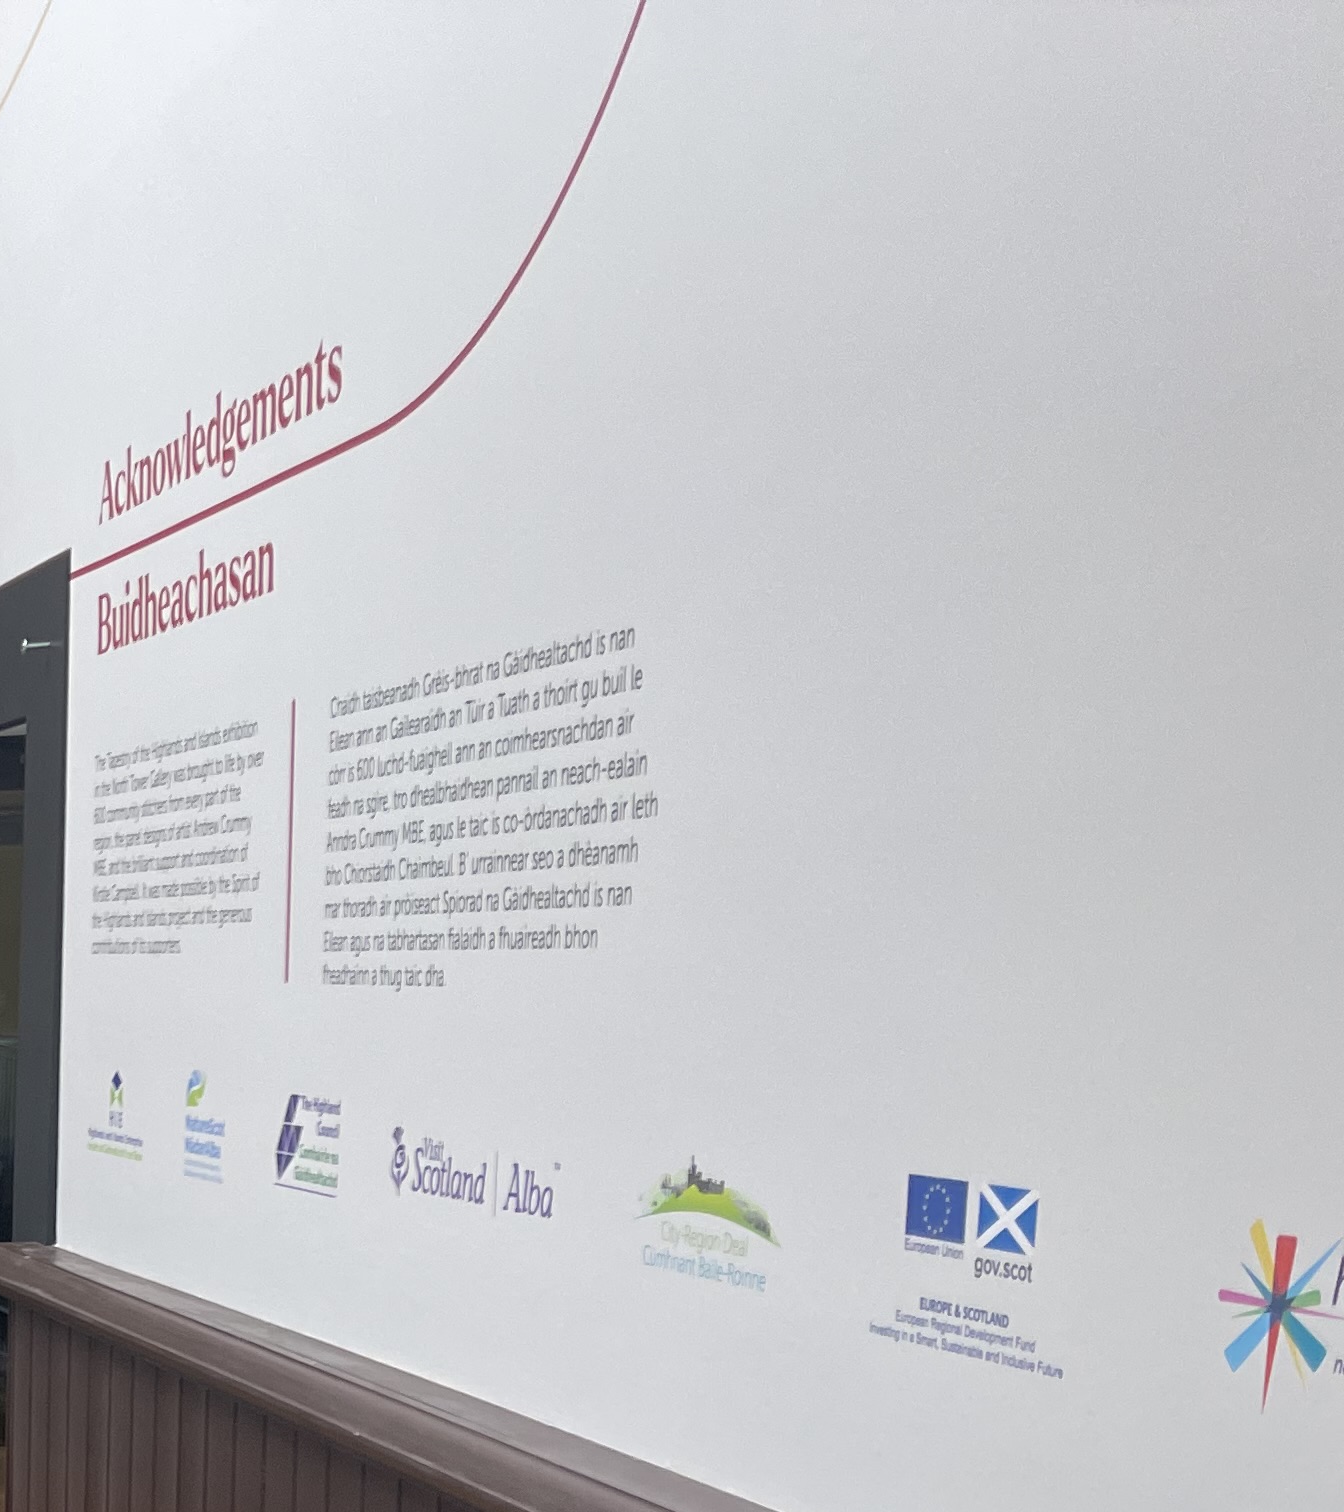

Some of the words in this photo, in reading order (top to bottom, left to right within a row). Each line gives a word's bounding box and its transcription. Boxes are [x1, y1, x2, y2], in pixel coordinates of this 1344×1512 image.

[97, 338, 344, 526] Acknowledgements
[97, 541, 275, 656] Buidheachasan
[486, 660, 500, 681] na
[595, 628, 606, 656] is
[609, 626, 635, 652] nan
[356, 726, 374, 747] ann
[374, 723, 388, 743] an
[448, 707, 462, 728] an
[487, 700, 495, 720] a
[497, 687, 530, 717] Tuath
[532, 690, 540, 711] a
[543, 677, 578, 708] thoirt
[581, 677, 598, 708] gu
[602, 665, 627, 697] buil
[630, 663, 643, 691] le
[347, 761, 355, 783] is
[356, 755, 375, 781] 600
[455, 742, 476, 764] ann
[477, 739, 492, 761] an
[495, 714, 613, 757] coimhearsnachdan
[616, 707, 635, 737] air
[353, 797, 364, 816] na
[392, 789, 408, 810] tro
[496, 764, 539, 802] pannail
[541, 767, 558, 790] an
[561, 749, 647, 786] neach-ealain
[358, 826, 399, 851] Crummy
[429, 821, 454, 847] agus
[455, 815, 467, 839] le
[468, 811, 489, 838] taic
[491, 809, 500, 835] is
[610, 794, 628, 823] air
[631, 790, 658, 820] leth
[471, 849, 529, 875] urrainnear
[531, 849, 554, 871] seo
[556, 848, 565, 869] a
[379, 893, 392, 917] air
[442, 888, 483, 919] Spiorad
[485, 892, 500, 912] na
[593, 880, 604, 908] is
[606, 885, 632, 906] nan
[350, 934, 371, 957] agus
[373, 933, 385, 951] na
[488, 930, 496, 950] a
[498, 923, 561, 950] fhuaireadh
[564, 923, 598, 949] bhon
[371, 968, 378, 986] a
[379, 964, 402, 992] thug
[404, 963, 423, 987] taic
[411, 1147, 487, 1205] Scotland
[502, 1162, 554, 1219] Alba
[904, 1237, 940, 1255] European
[941, 1241, 964, 1260] Union
[974, 1257, 1033, 1283] gov.scot
[895, 1310, 929, 1328] European
[965, 1323, 1014, 1347] Development
[1016, 1336, 1037, 1353] Fund
[919, 1297, 952, 1317] EUROPE
[954, 1305, 961, 1318] &
[963, 1306, 1009, 1328] SCOTLAND
[1037, 1361, 1064, 1379] Future
